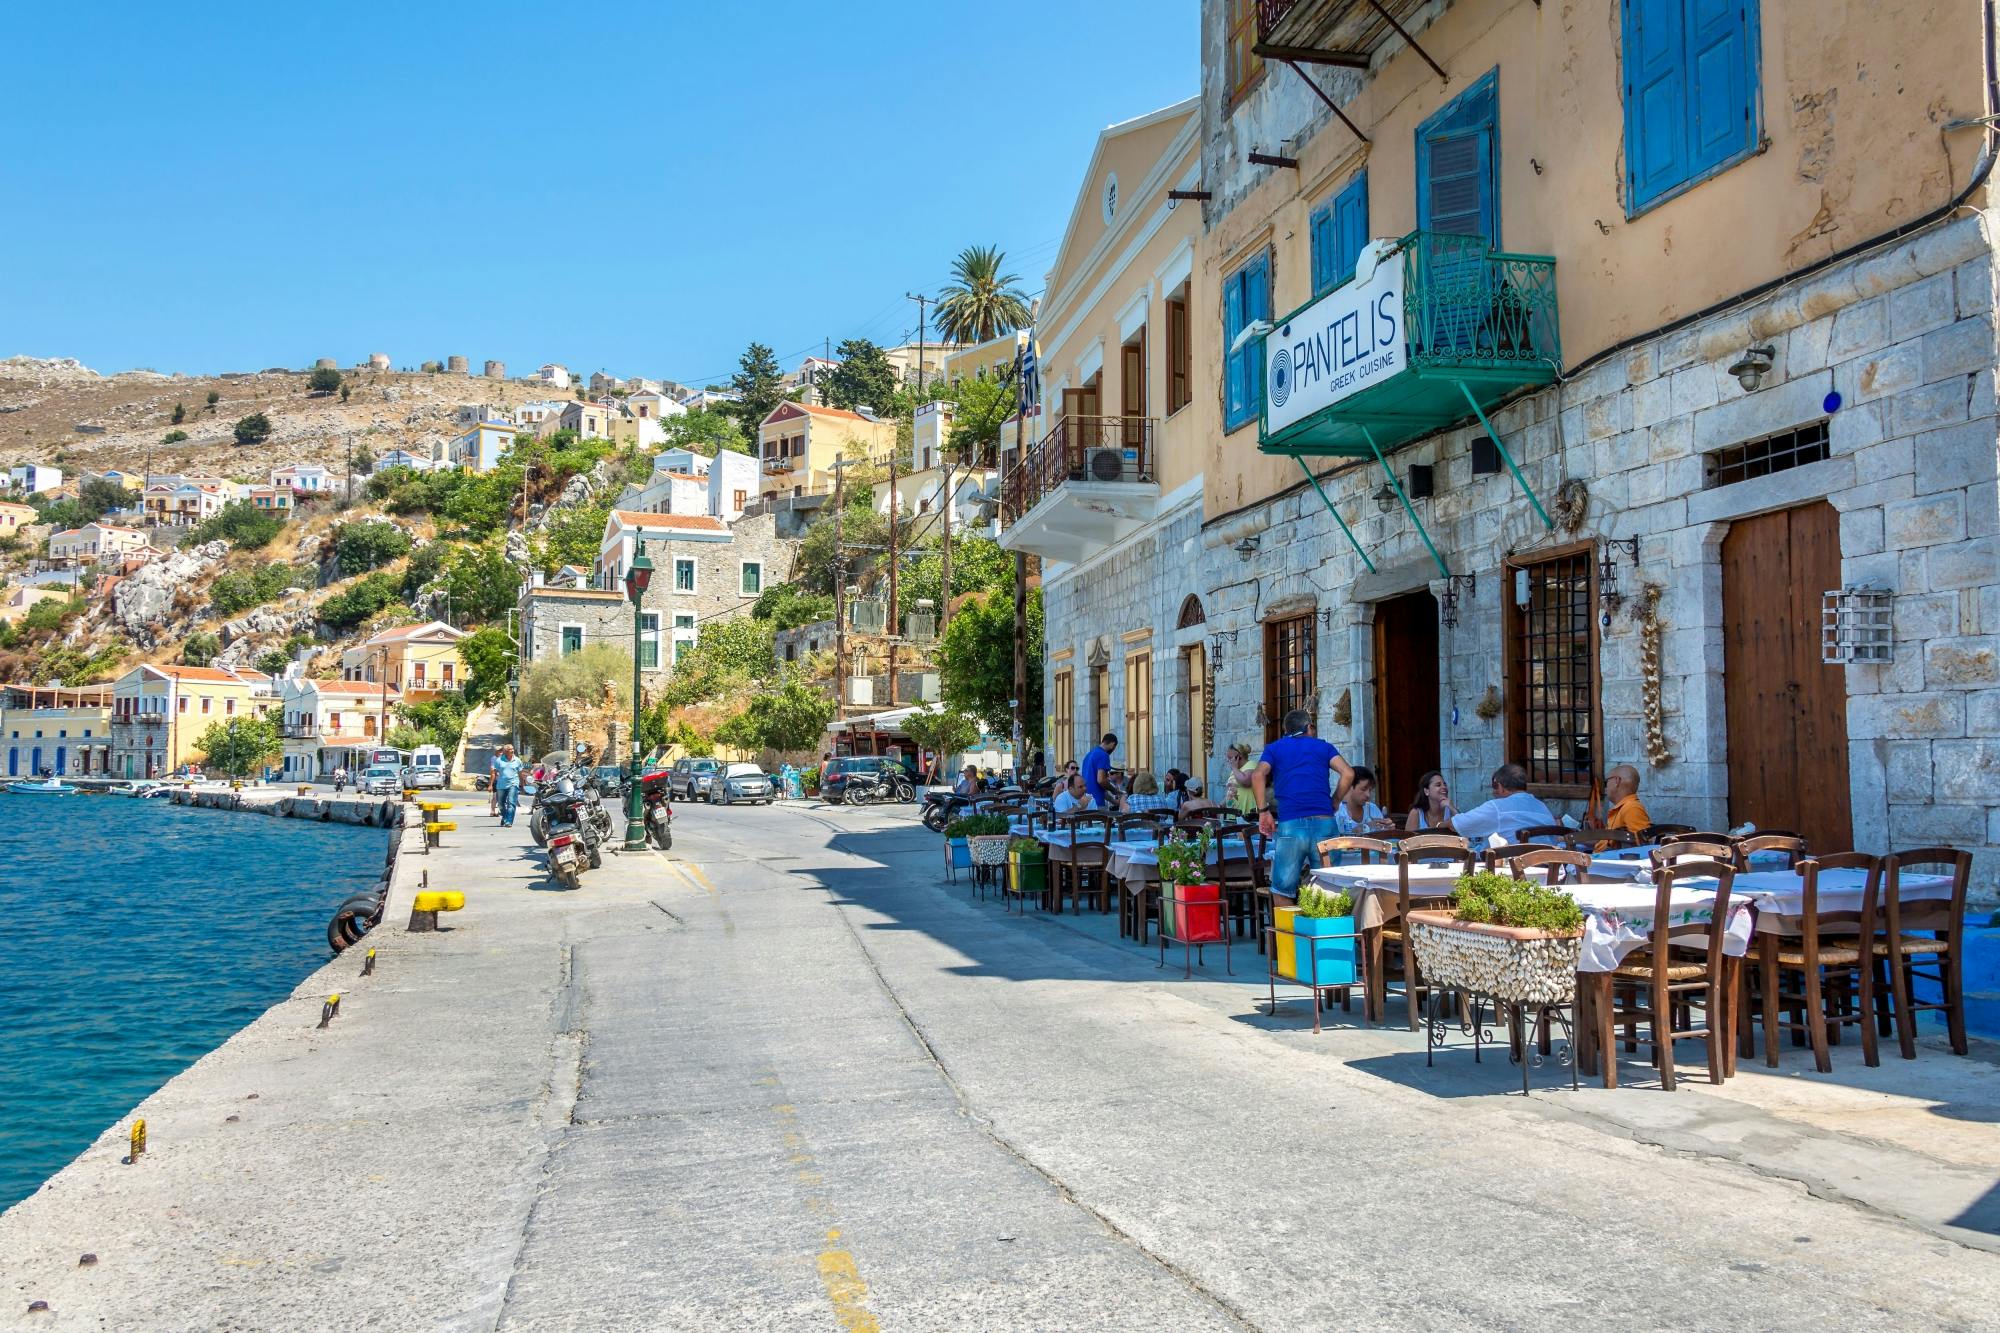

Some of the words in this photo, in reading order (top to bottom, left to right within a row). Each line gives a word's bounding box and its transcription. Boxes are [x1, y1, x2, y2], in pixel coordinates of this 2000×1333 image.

[1294, 291, 1395, 392] PANTELIS
[1330, 369, 1356, 392] GREEK
[1359, 351, 1394, 378] CUISINE
